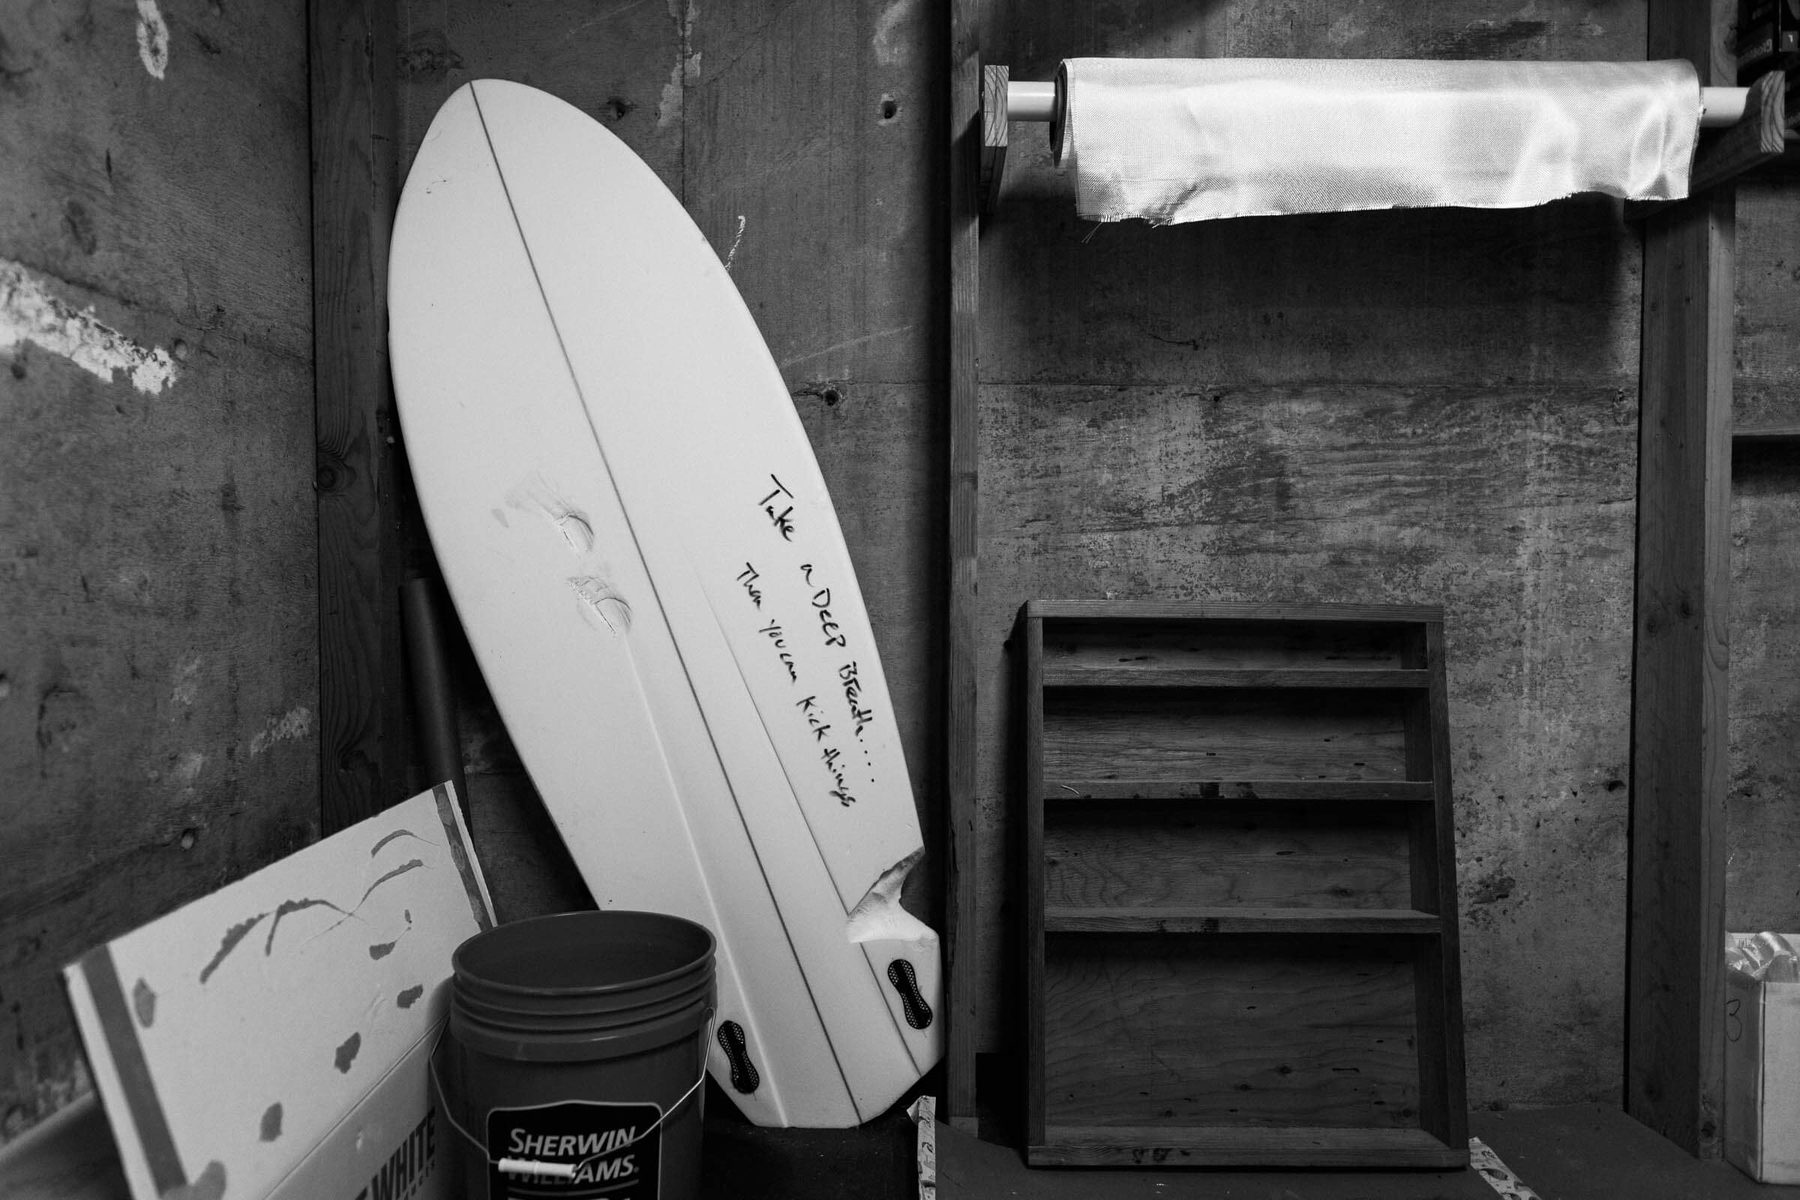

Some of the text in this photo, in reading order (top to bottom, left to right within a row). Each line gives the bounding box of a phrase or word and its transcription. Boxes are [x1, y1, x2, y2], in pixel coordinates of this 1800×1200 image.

[758, 473, 795, 543] Take
[800, 563, 816, 588] a
[736, 562, 762, 611] Then
[821, 748, 857, 808] things
[507, 1125, 637, 1157] SHERWIN
